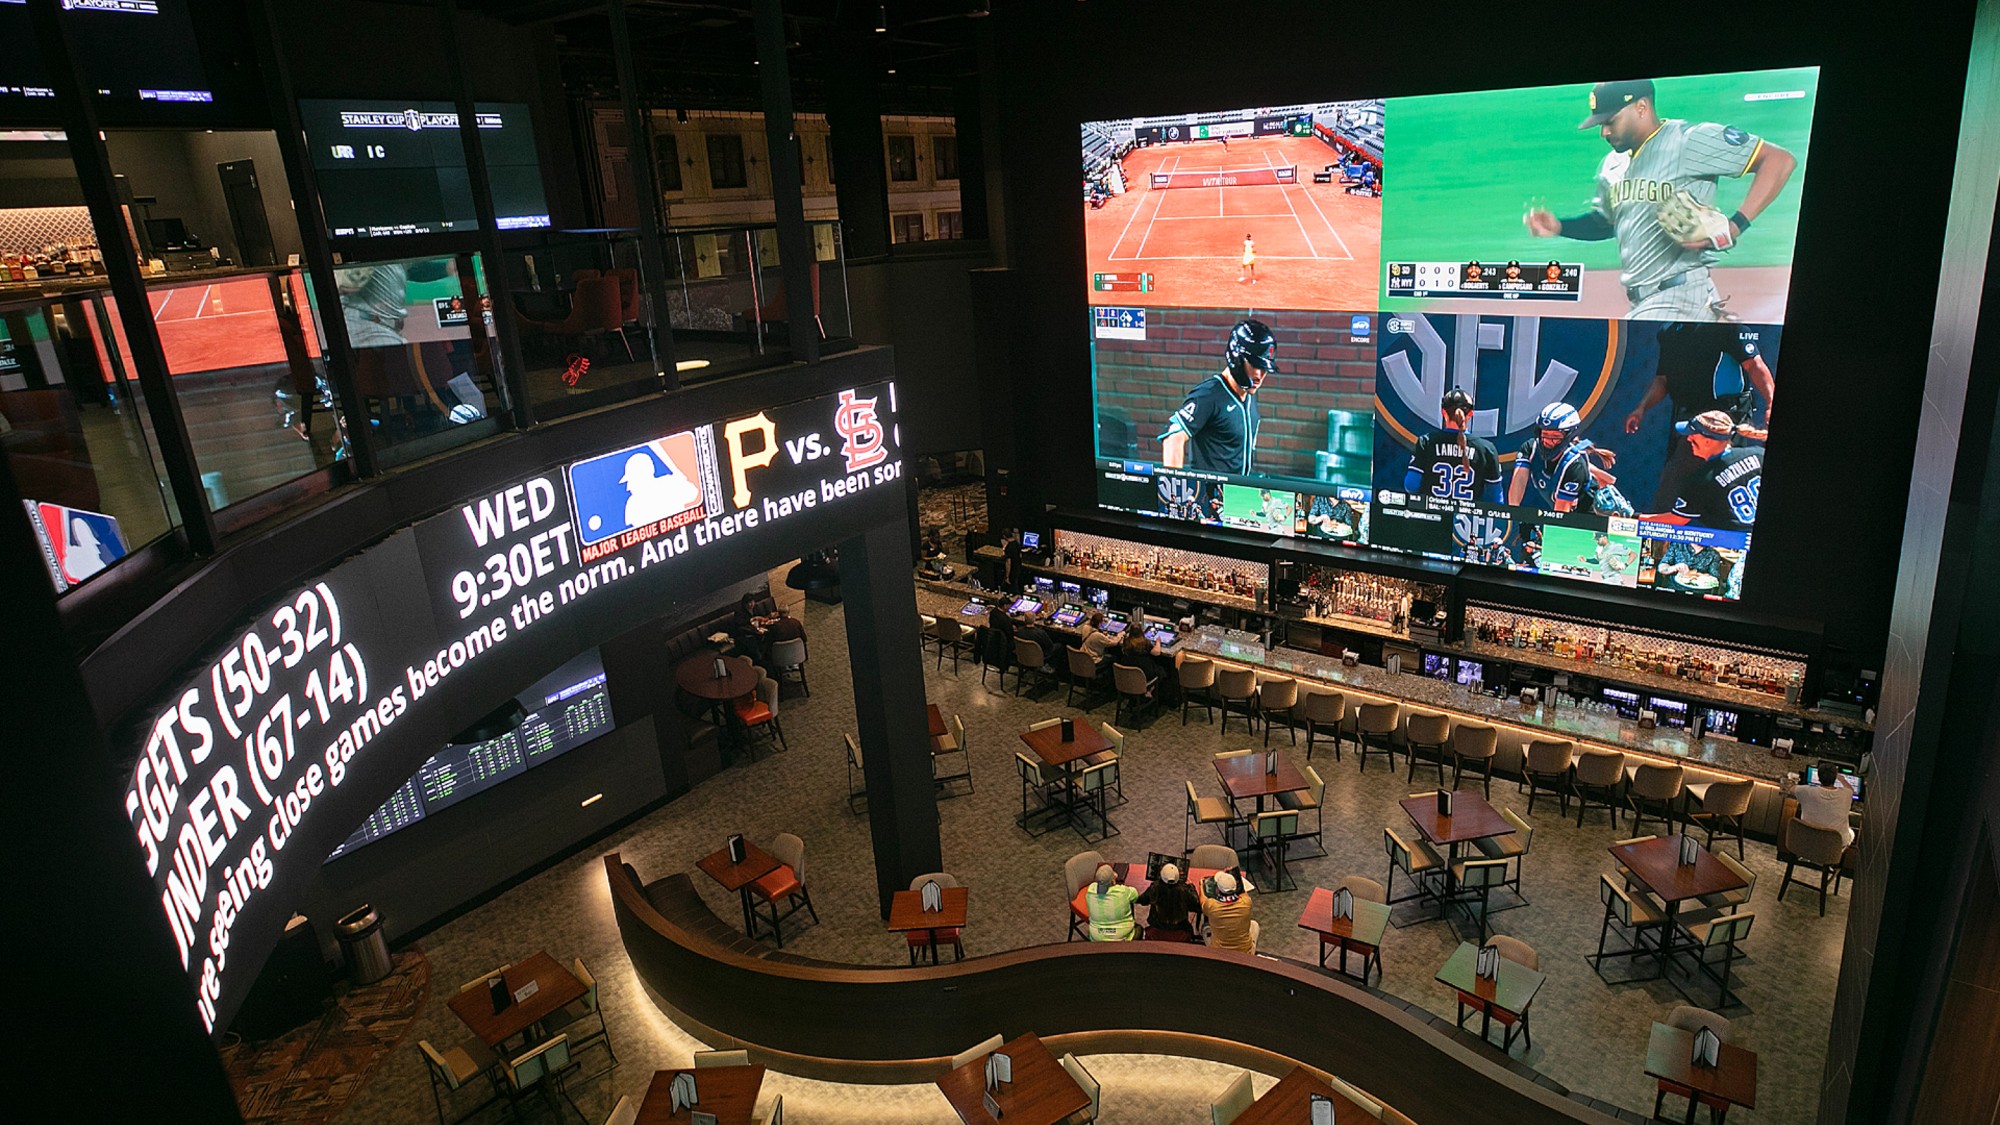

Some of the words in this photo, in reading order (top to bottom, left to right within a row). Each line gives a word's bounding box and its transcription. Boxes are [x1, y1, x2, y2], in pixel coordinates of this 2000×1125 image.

[342, 114, 385, 125] STANLEY
[387, 115, 405, 125] CUP
[421, 115, 459, 125] PLAYOF
[1221, 177, 1237, 186] TOUR
[1402, 266, 1411, 275] SD
[1420, 266, 1426, 275] 0
[1434, 266, 1441, 275] 0
[1448, 266, 1455, 275] 0
[1482, 268, 1497, 276] .243
[1401, 279, 1413, 288] NYY
[1419, 279, 1426, 287] 0
[1447, 279, 1454, 288] 0
[1464, 282, 1489, 290] BOGAERTS
[1739, 333, 1759, 341] LIVE
[724, 411, 780, 509] P
[785, 433, 831, 464] vs.
[1431, 462, 1475, 500] 32
[1428, 496, 1449, 504] Orioles
[1459, 500, 1476, 508] Twins
[462, 477, 556, 548] WED
[1556, 511, 1564, 519] ET
[582, 537, 619, 563] MAJOR
[621, 524, 659, 548] LEAGUE
[659, 506, 707, 535] BASEBALL
[1639, 530, 1668, 539] SATURDAY
[1645, 525, 1676, 534] OKLAHOMA
[1684, 530, 1715, 539] KENTUCKY
[451, 521, 572, 619] 9:30ET
[211, 581, 342, 740] (50-32)
[210, 834, 274, 973] seeing
[268, 763, 325, 851] close
[324, 685, 407, 787] games
[406, 616, 507, 701] become
[511, 590, 555, 631] the
[558, 556, 635, 605] norm.
[640, 524, 689, 568] And
[693, 508, 759, 546] there
[763, 488, 817, 522] have
[820, 471, 871, 503] been
[245, 642, 368, 806] (67-14)
